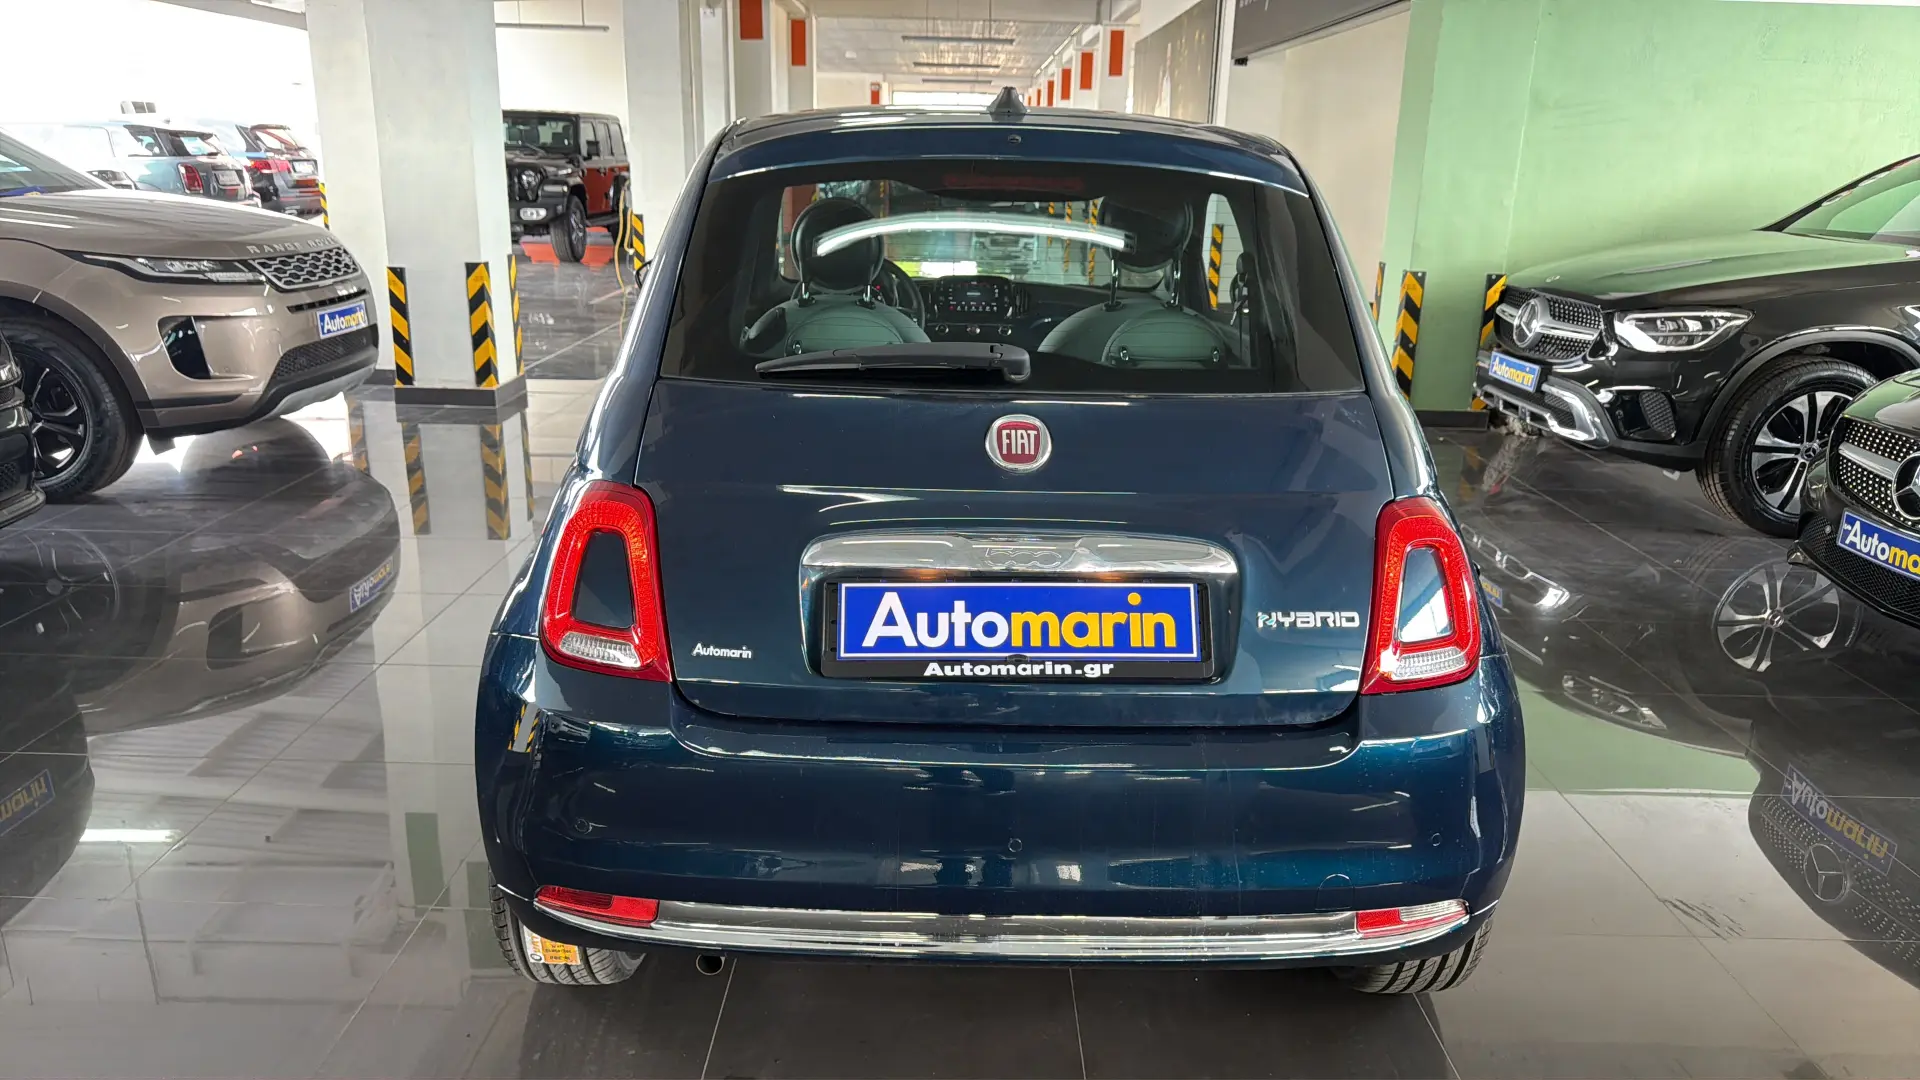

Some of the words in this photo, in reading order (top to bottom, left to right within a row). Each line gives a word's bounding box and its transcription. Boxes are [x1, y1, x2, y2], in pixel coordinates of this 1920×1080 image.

[1492, 356, 1534, 387] Automarin
[1001, 429, 1037, 455] FIAT
[862, 591, 1177, 648] Automarin
[1257, 611, 1360, 628] HYBRID
[691, 642, 752, 659] Automarin
[923, 661, 1114, 678] Automarin.gr
